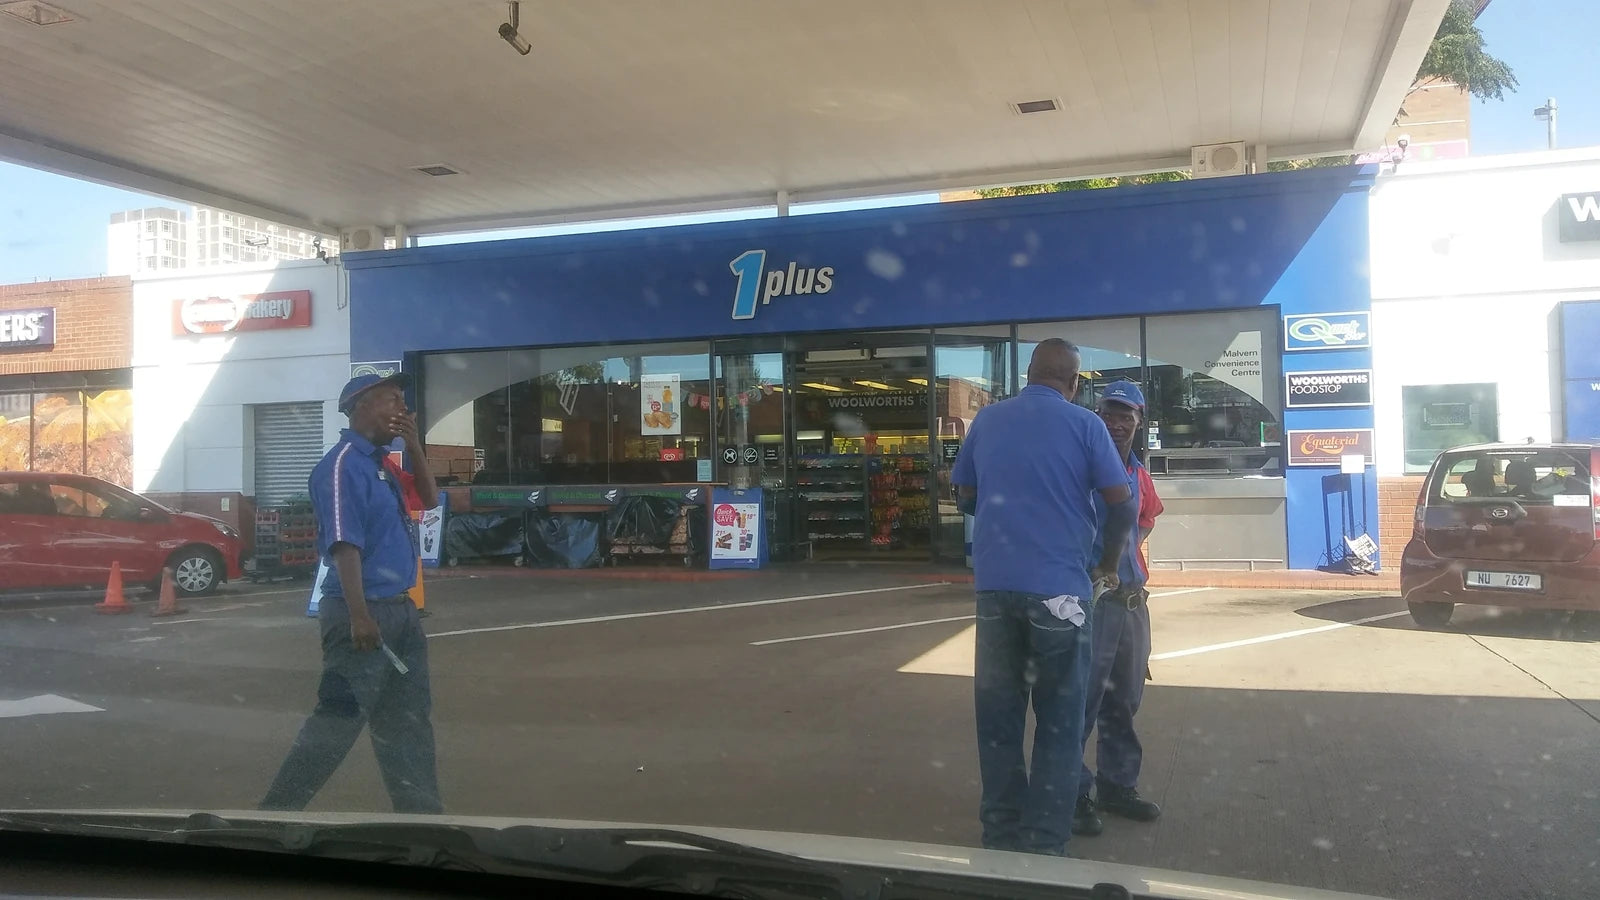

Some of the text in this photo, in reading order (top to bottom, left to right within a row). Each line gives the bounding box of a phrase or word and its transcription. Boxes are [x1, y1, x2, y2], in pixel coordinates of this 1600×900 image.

[1204, 360, 1260, 368] Convenience
[1291, 374, 1368, 386] WOOLWORTHS
[828, 396, 914, 408] WOOLWORTHS
[1301, 432, 1359, 455] Equatorial
[717, 515, 733, 523] SAVE
[1478, 573, 1531, 586] NU 7627
